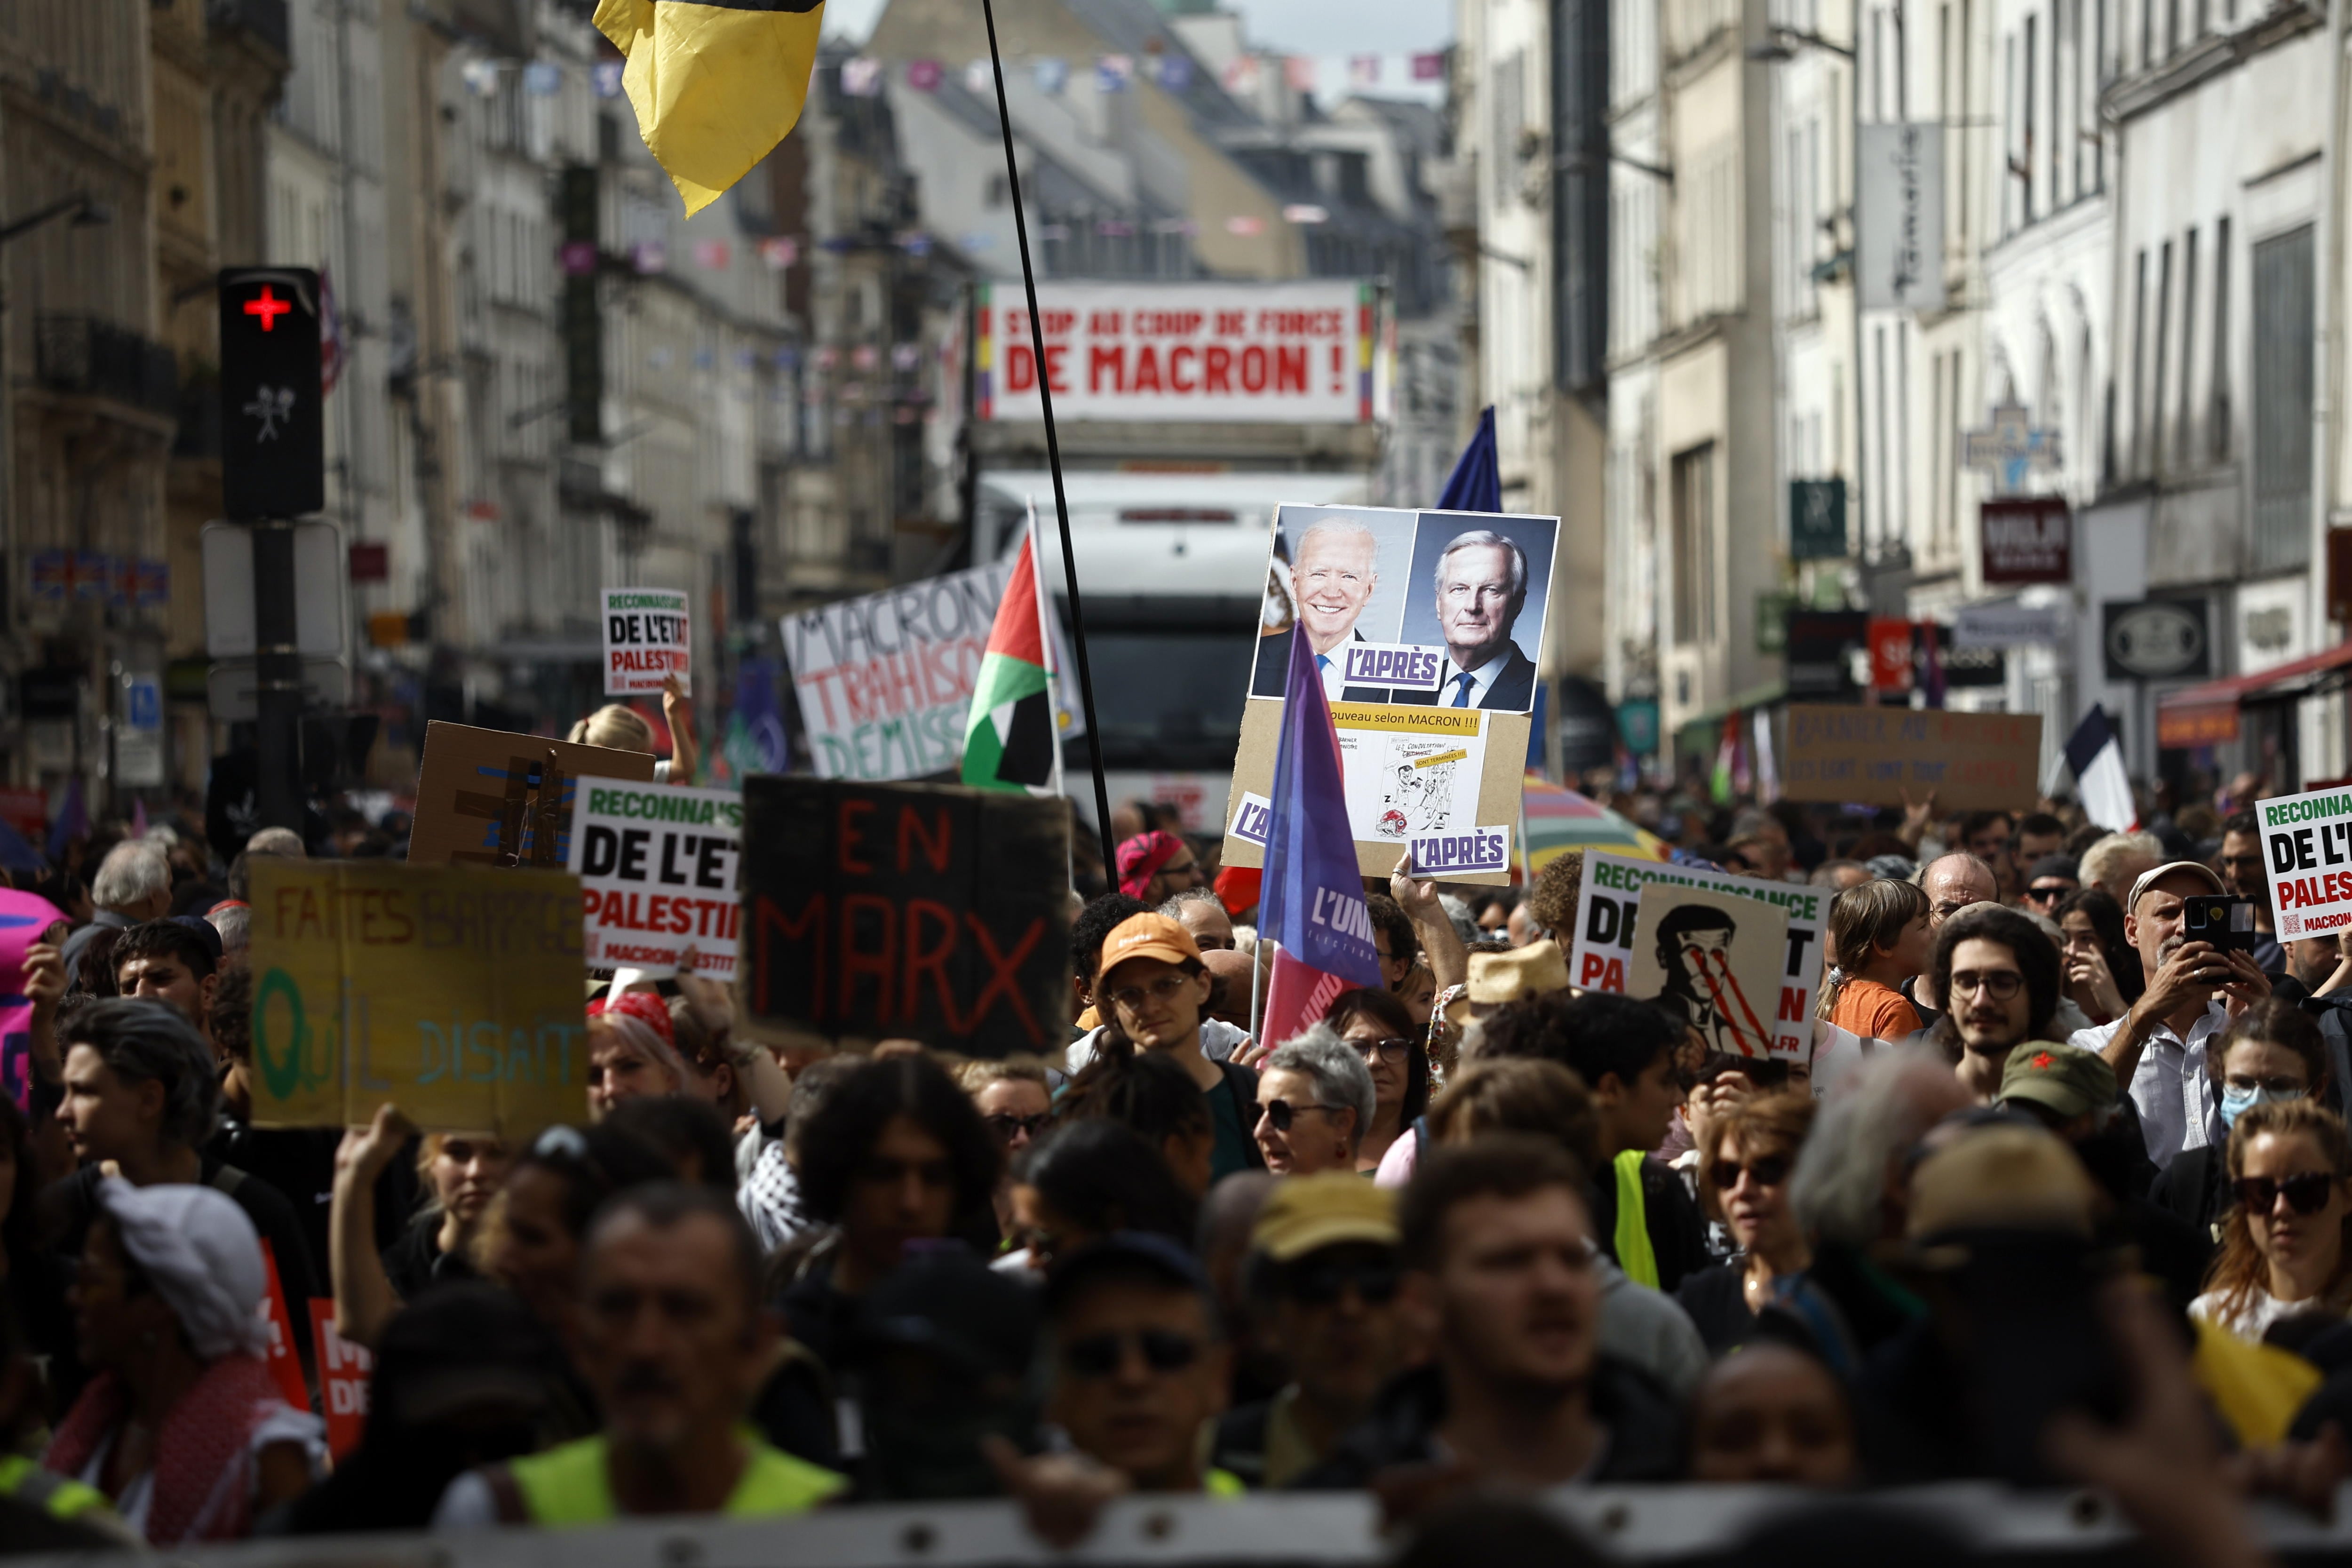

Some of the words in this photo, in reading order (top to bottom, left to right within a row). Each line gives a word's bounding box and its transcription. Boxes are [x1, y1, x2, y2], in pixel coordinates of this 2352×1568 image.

[1004, 308, 1077, 336] STOP
[1086, 308, 1123, 336] AU
[1133, 308, 1203, 337] COUP
[1213, 308, 1248, 337] DE
[1256, 308, 1346, 337] FORCE
[1005, 345, 1069, 394] DE
[1089, 345, 1307, 394] MACRON
[1329, 346, 1344, 394] !
[609, 615, 641, 644] DE
[796, 569, 1003, 674] MACRON
[798, 635, 990, 732] TRAHISO
[1344, 646, 1438, 686] L'APRÈS
[818, 701, 970, 780] DEMISS
[1331, 711, 1371, 722] ouveau
[1375, 712, 1404, 724] selon
[1408, 714, 1461, 727] MACRON
[1465, 716, 1478, 728] !!!
[1430, 753, 1457, 763] TERMINÉES
[589, 788, 742, 827] RECONNAS
[1235, 802, 1271, 844] L'A
[2265, 794, 2352, 827] RECONNA
[581, 825, 651, 881] DE
[660, 832, 741, 890] L'E
[839, 800, 952, 875] EN
[1412, 829, 1503, 874] L'APRÈS
[2269, 828, 2317, 875] DE
[2320, 821, 2352, 866] L'
[582, 887, 741, 940] PALESTI
[2277, 871, 2352, 911] PALES
[1311, 885, 1376, 948] L'UNI
[2304, 912, 2352, 932] MACRON
[755, 892, 1047, 1046] MARX
